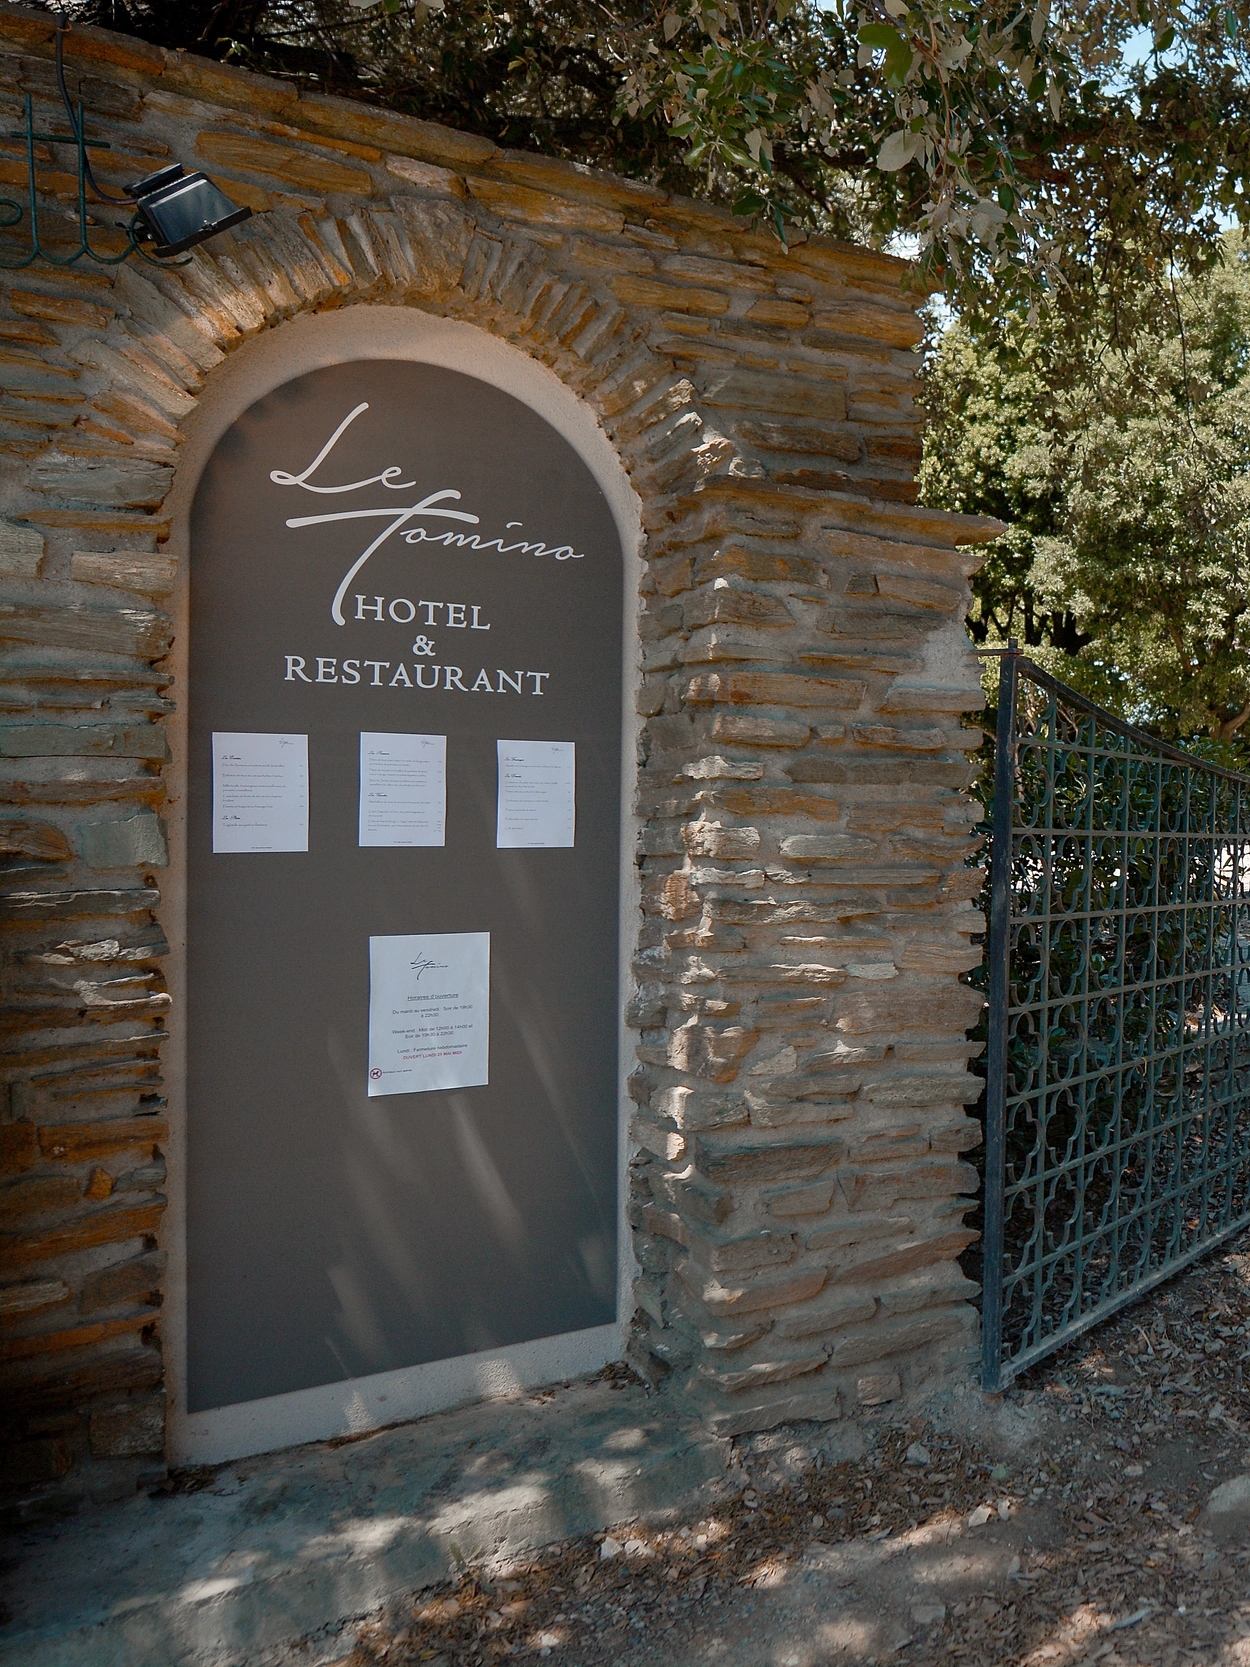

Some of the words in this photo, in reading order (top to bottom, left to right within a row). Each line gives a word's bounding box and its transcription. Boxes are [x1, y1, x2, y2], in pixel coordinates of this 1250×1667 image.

[269, 402, 416, 494] Le
[285, 489, 584, 626] Tomino
[354, 594, 491, 631] HOTEL
[412, 635, 436, 656] &
[284, 655, 550, 695] RESTAURANT
